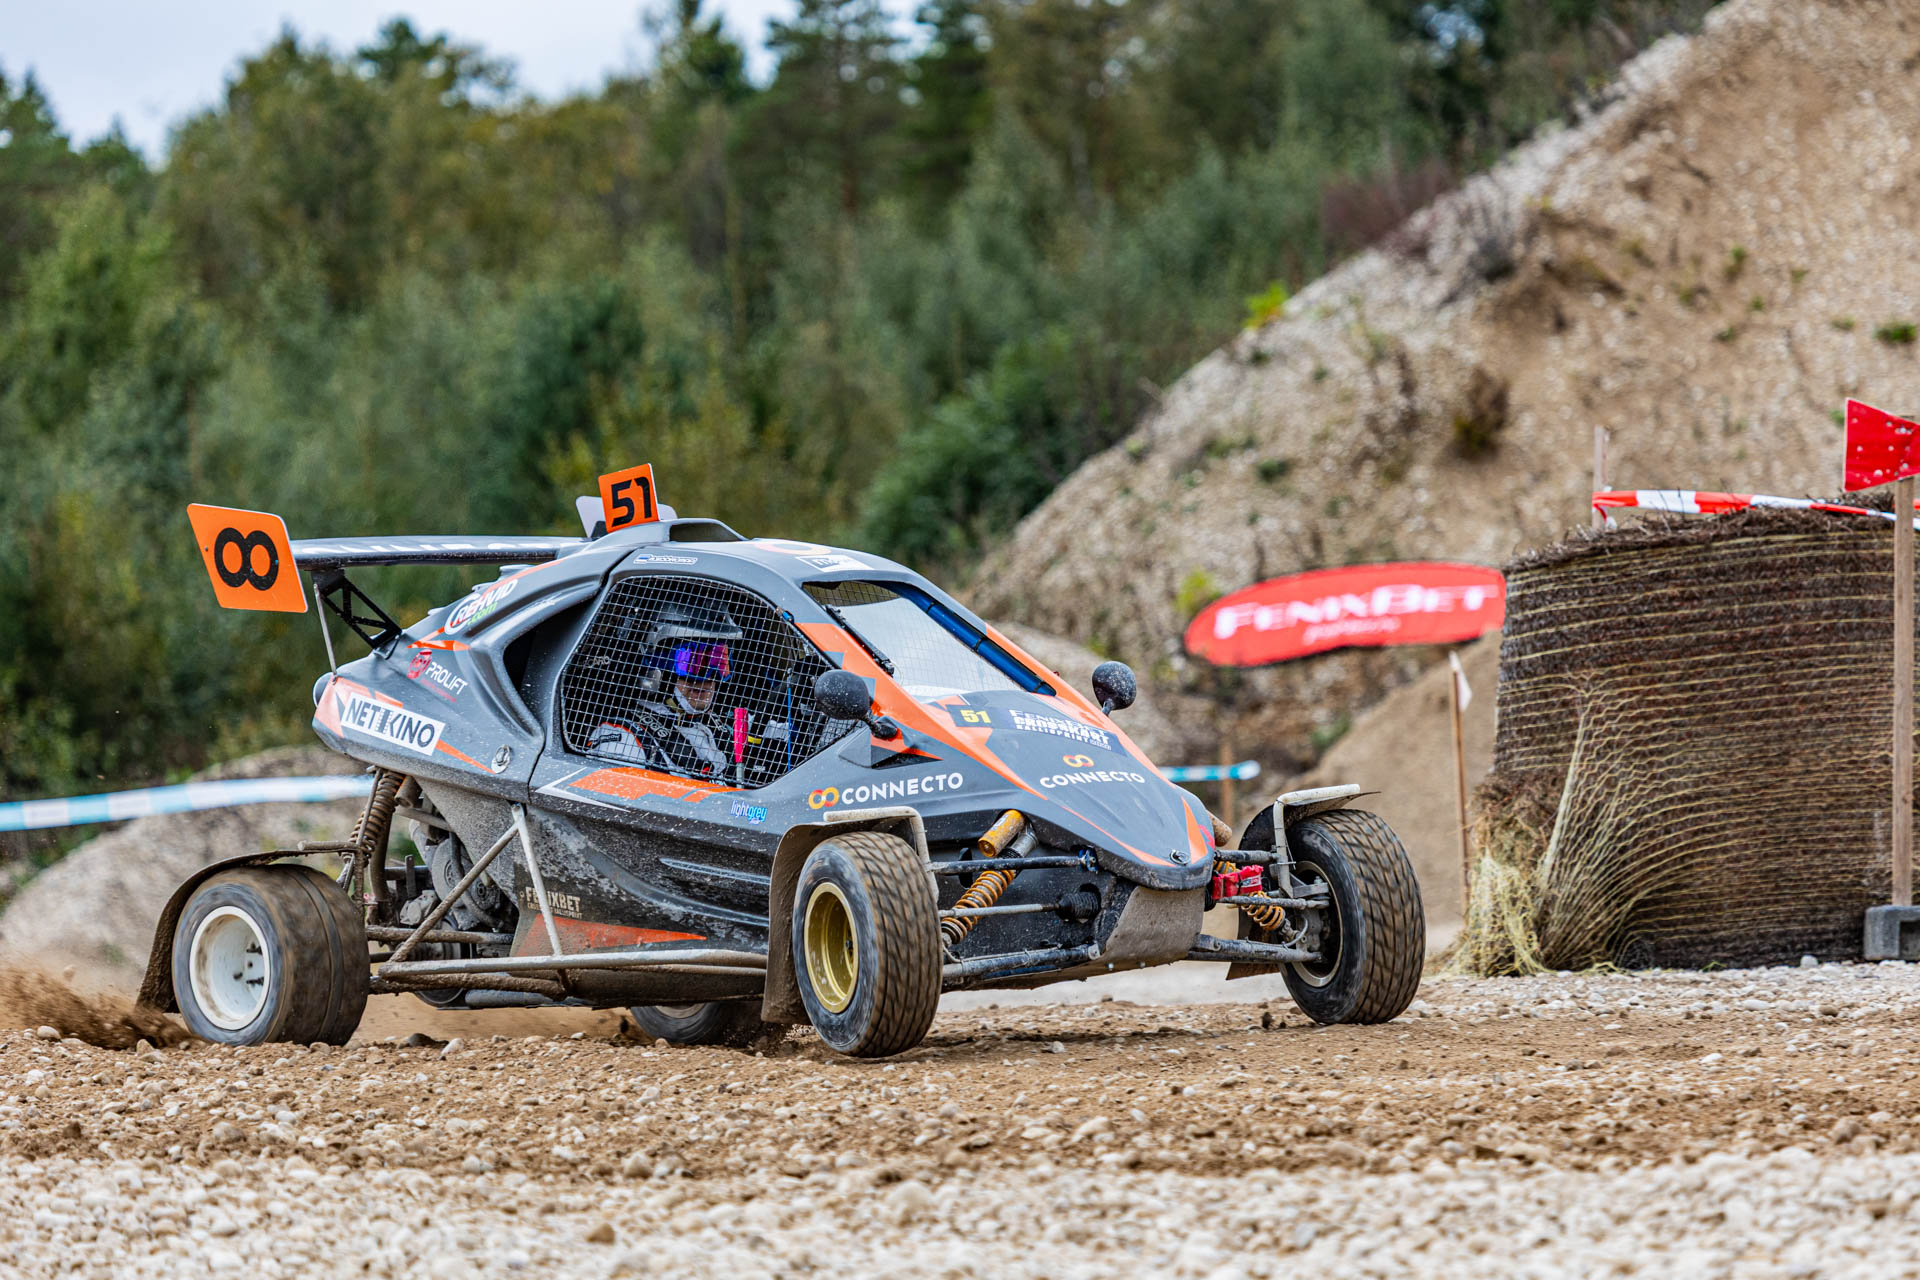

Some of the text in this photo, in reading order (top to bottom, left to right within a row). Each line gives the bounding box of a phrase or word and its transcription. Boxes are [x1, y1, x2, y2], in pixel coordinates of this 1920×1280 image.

[611, 476, 652, 527] 51
[425, 661, 468, 695] PROLIFT
[960, 709, 992, 724] 51
[841, 772, 964, 805] CONNECTO
[1039, 770, 1145, 789] CONNECTO
[730, 799, 768, 823] lightgrey
[525, 886, 581, 912] FEIXBET
